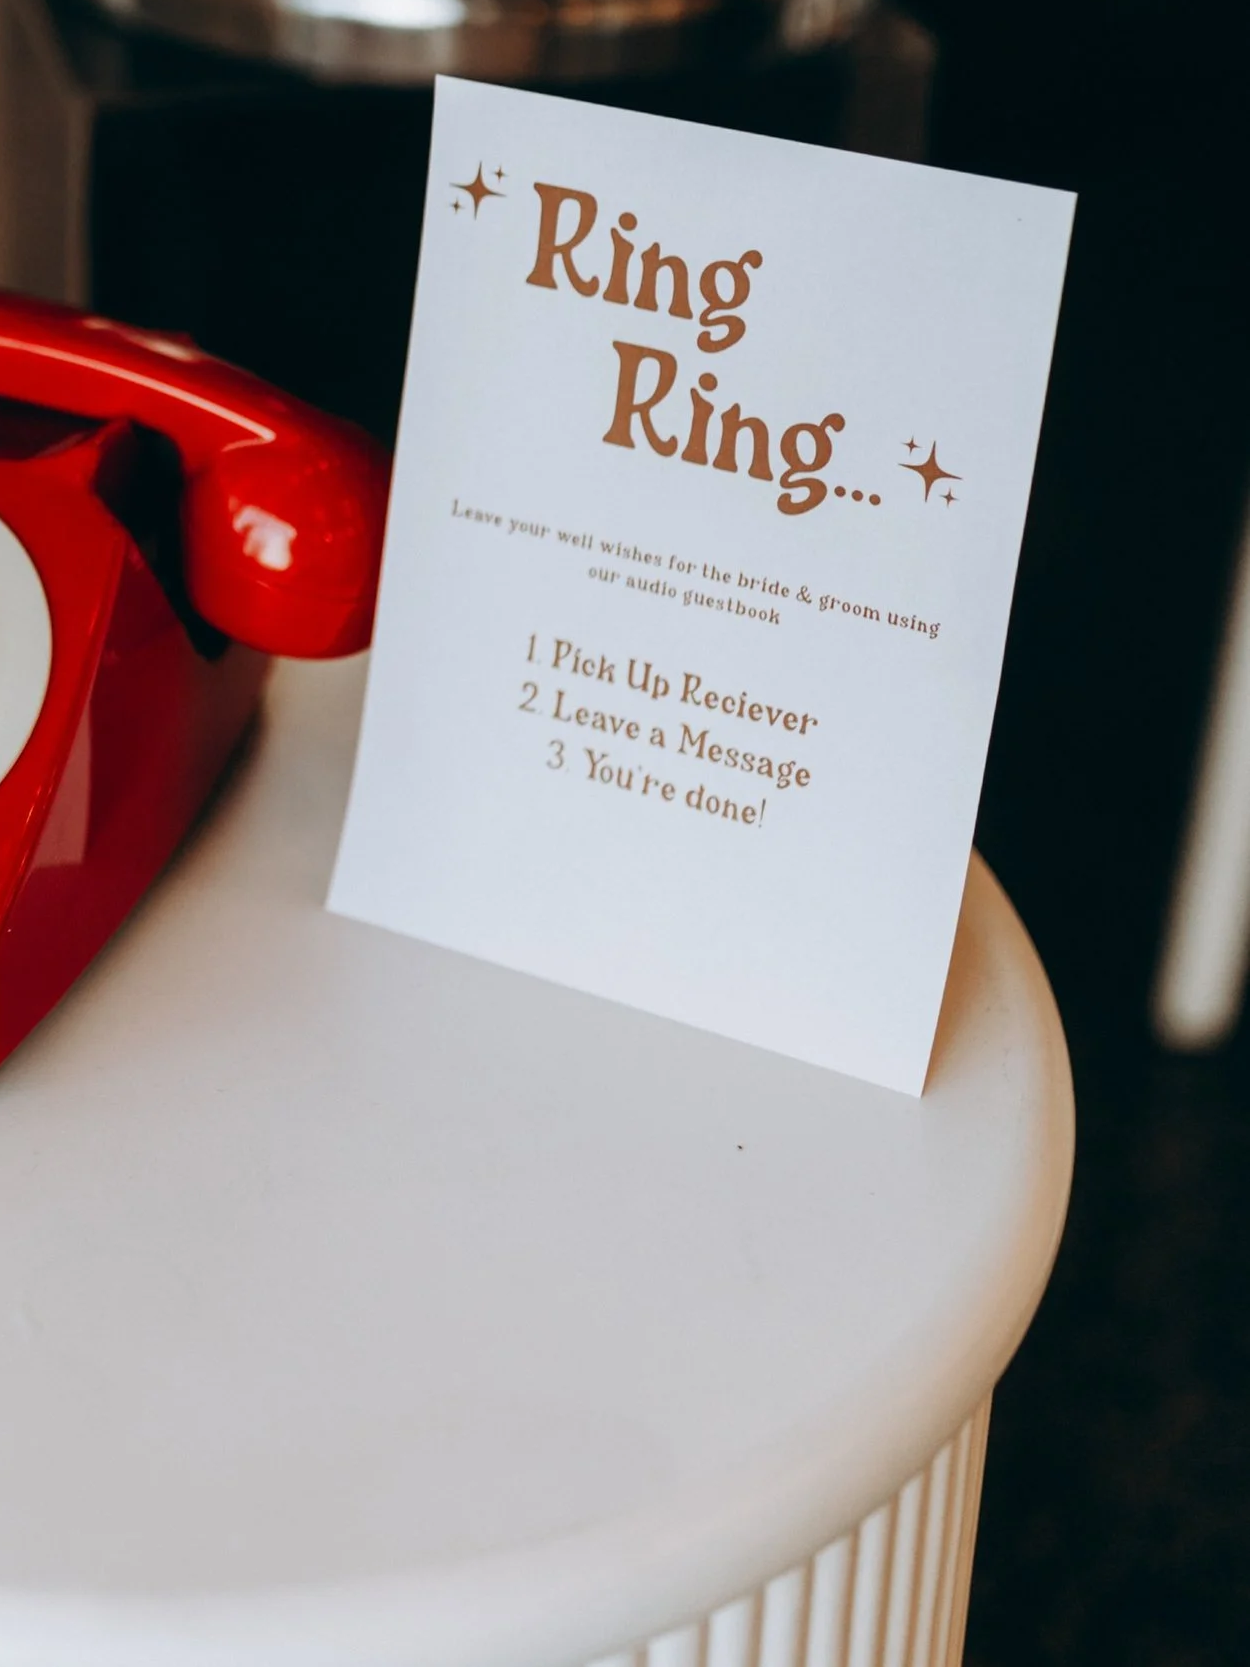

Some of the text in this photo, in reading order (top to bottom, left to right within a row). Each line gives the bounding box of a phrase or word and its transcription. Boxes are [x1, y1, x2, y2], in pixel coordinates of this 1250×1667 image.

[526, 181, 763, 353] Ring
[602, 340, 881, 515] Ring...
[451, 498, 941, 639] Leave your well wishes for the bride & groom using
[588, 564, 781, 625] our audio guestbook
[550, 639, 617, 683] Pick
[627, 660, 671, 699] Up
[680, 673, 819, 736] Reciever
[552, 689, 641, 741] Leave
[648, 727, 667, 748] a
[678, 724, 812, 789] Message
[583, 749, 676, 802] You're
[685, 784, 767, 828] done!
